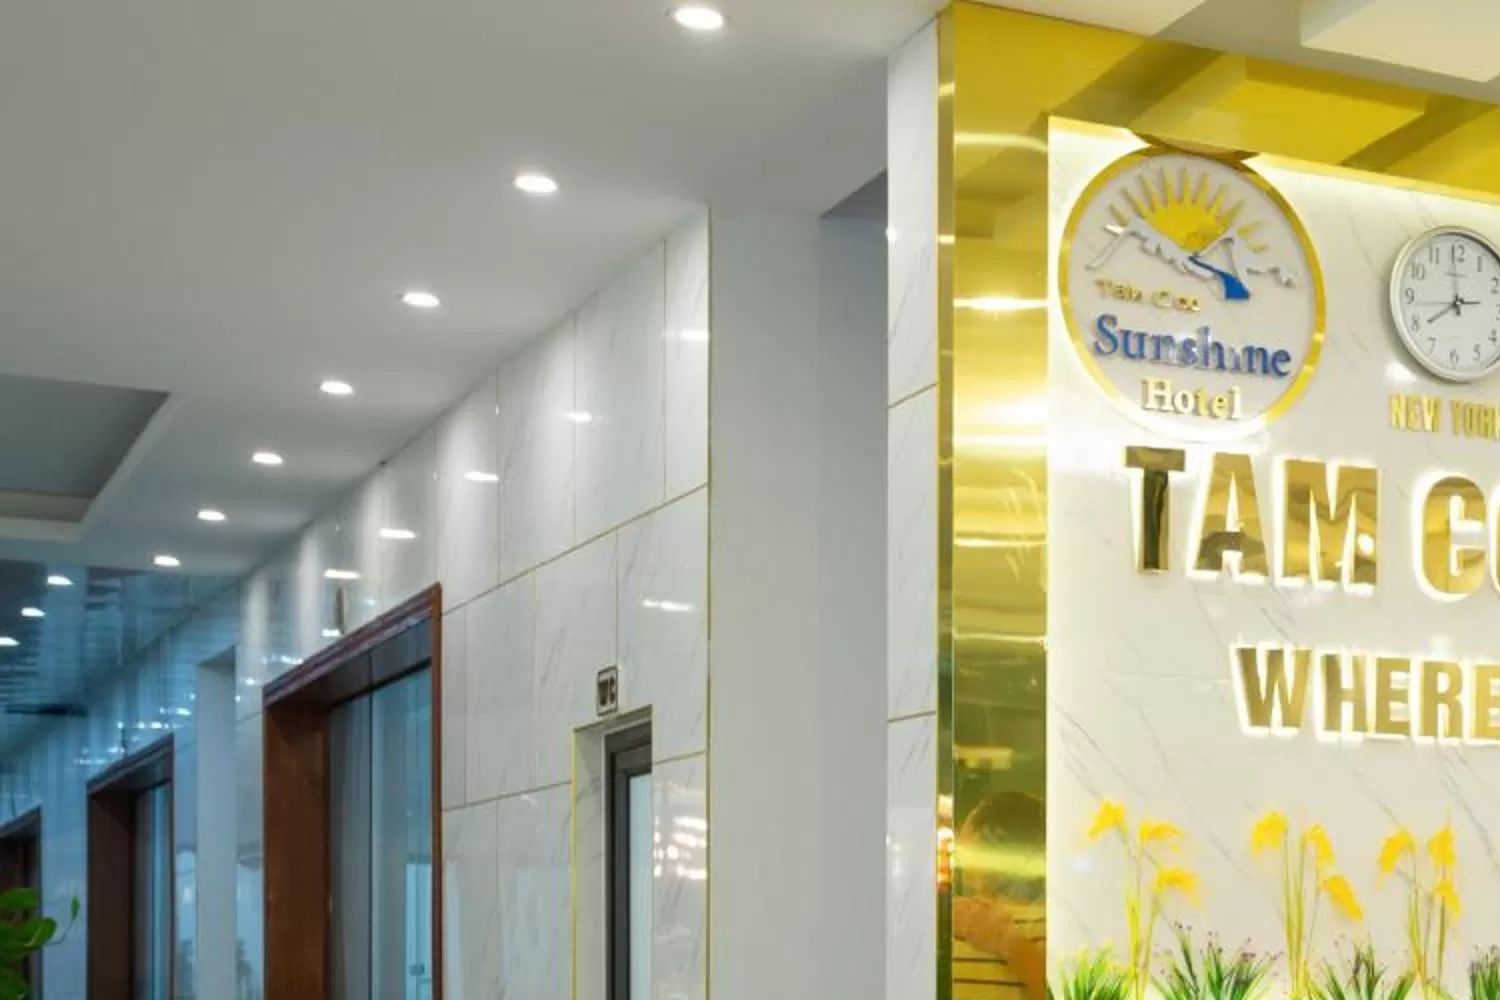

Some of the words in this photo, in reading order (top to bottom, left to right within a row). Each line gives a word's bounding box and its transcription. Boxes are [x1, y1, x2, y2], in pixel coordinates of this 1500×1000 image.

[1094, 313, 1292, 377] Sunshine
[1141, 377, 1243, 420] Hotel
[1391, 393, 1441, 432] NEW
[1125, 445, 1378, 586] TAM
